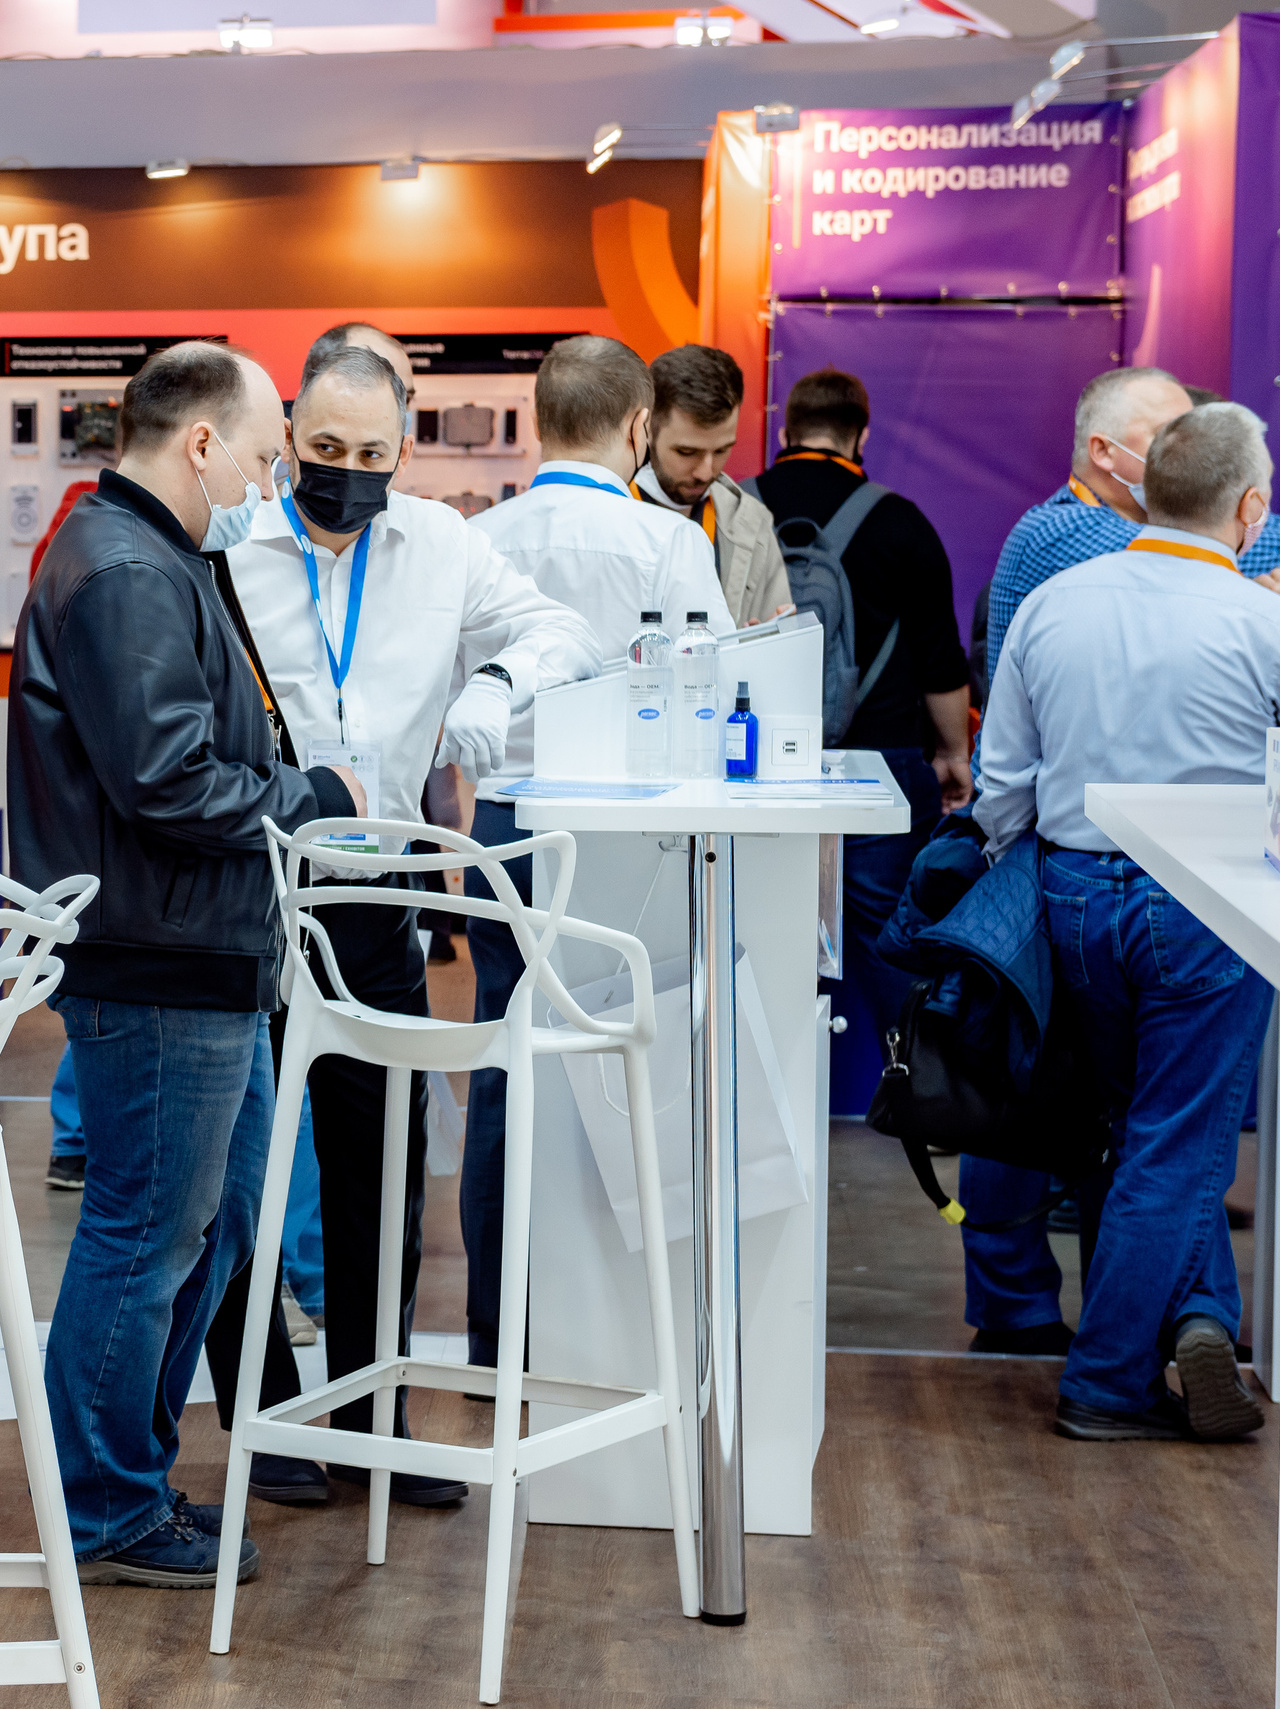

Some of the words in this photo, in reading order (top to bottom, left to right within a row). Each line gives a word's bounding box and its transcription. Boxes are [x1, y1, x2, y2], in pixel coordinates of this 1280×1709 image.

[813, 120, 1103, 159] Персонализация
[812, 168, 835, 194] и
[841, 162, 1070, 198] кодирование
[812, 209, 893, 242] карт
